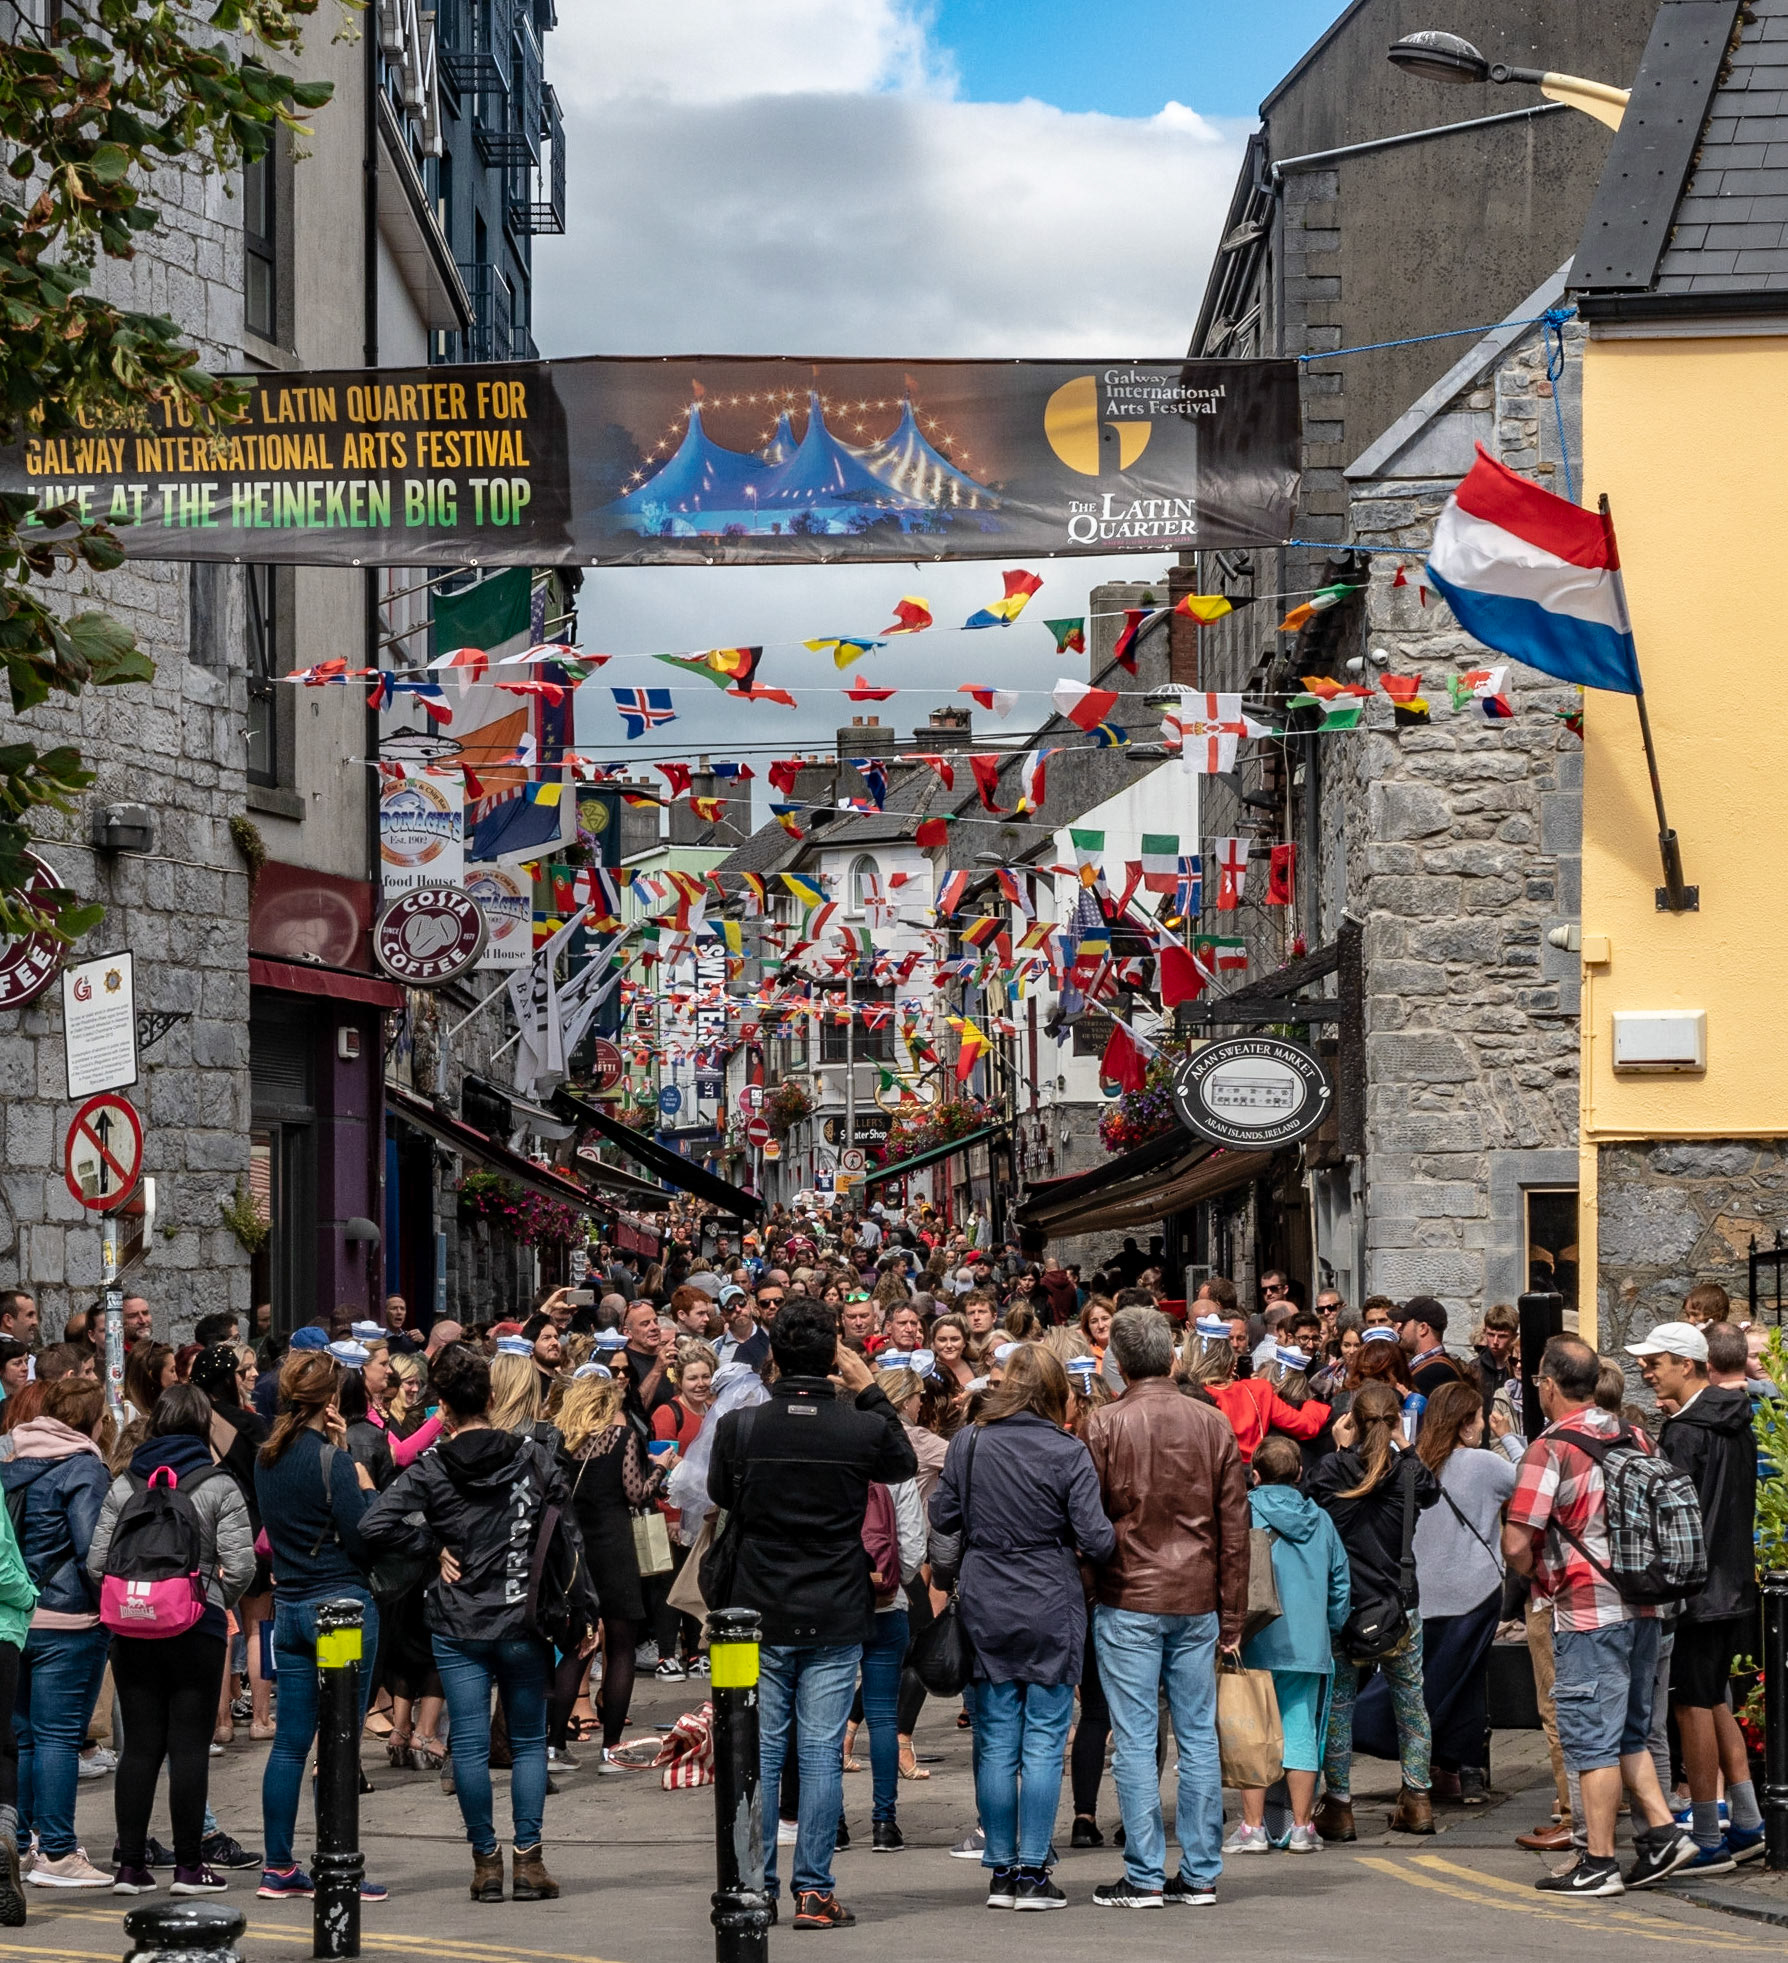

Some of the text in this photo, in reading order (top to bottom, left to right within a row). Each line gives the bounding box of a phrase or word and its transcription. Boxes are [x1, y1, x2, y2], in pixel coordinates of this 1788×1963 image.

[1104, 369, 1168, 386] Galway
[1106, 384, 1226, 400] International
[261, 386, 338, 424] LATIN
[346, 382, 468, 424] QUARTER
[476, 381, 528, 420] FOR
[1106, 398, 1217, 415] Arts Festival
[26, 430, 531, 476] GALWAY INTERNATIONAL ARTS FESTIVAL
[109, 483, 149, 527] AT
[158, 482, 219, 528] THE
[231, 479, 391, 528] HEINEKEN
[404, 478, 458, 527] BIG
[468, 477, 532, 527] TOP
[1100, 492, 1196, 520] LATIN
[1067, 514, 1198, 545] QUARTER
[390, 835, 406, 845] Est.
[383, 874, 457, 887] food House
[402, 891, 471, 918] COSTA
[382, 926, 400, 935] SINCE
[383, 942, 467, 977] COFFEE
[493, 948, 526, 959] House
[1190, 1043, 1316, 1081] ARAN SWEATER MARKET
[1204, 1117, 1227, 1134] ARAN
[840, 1128, 887, 1141] Sater Shop
